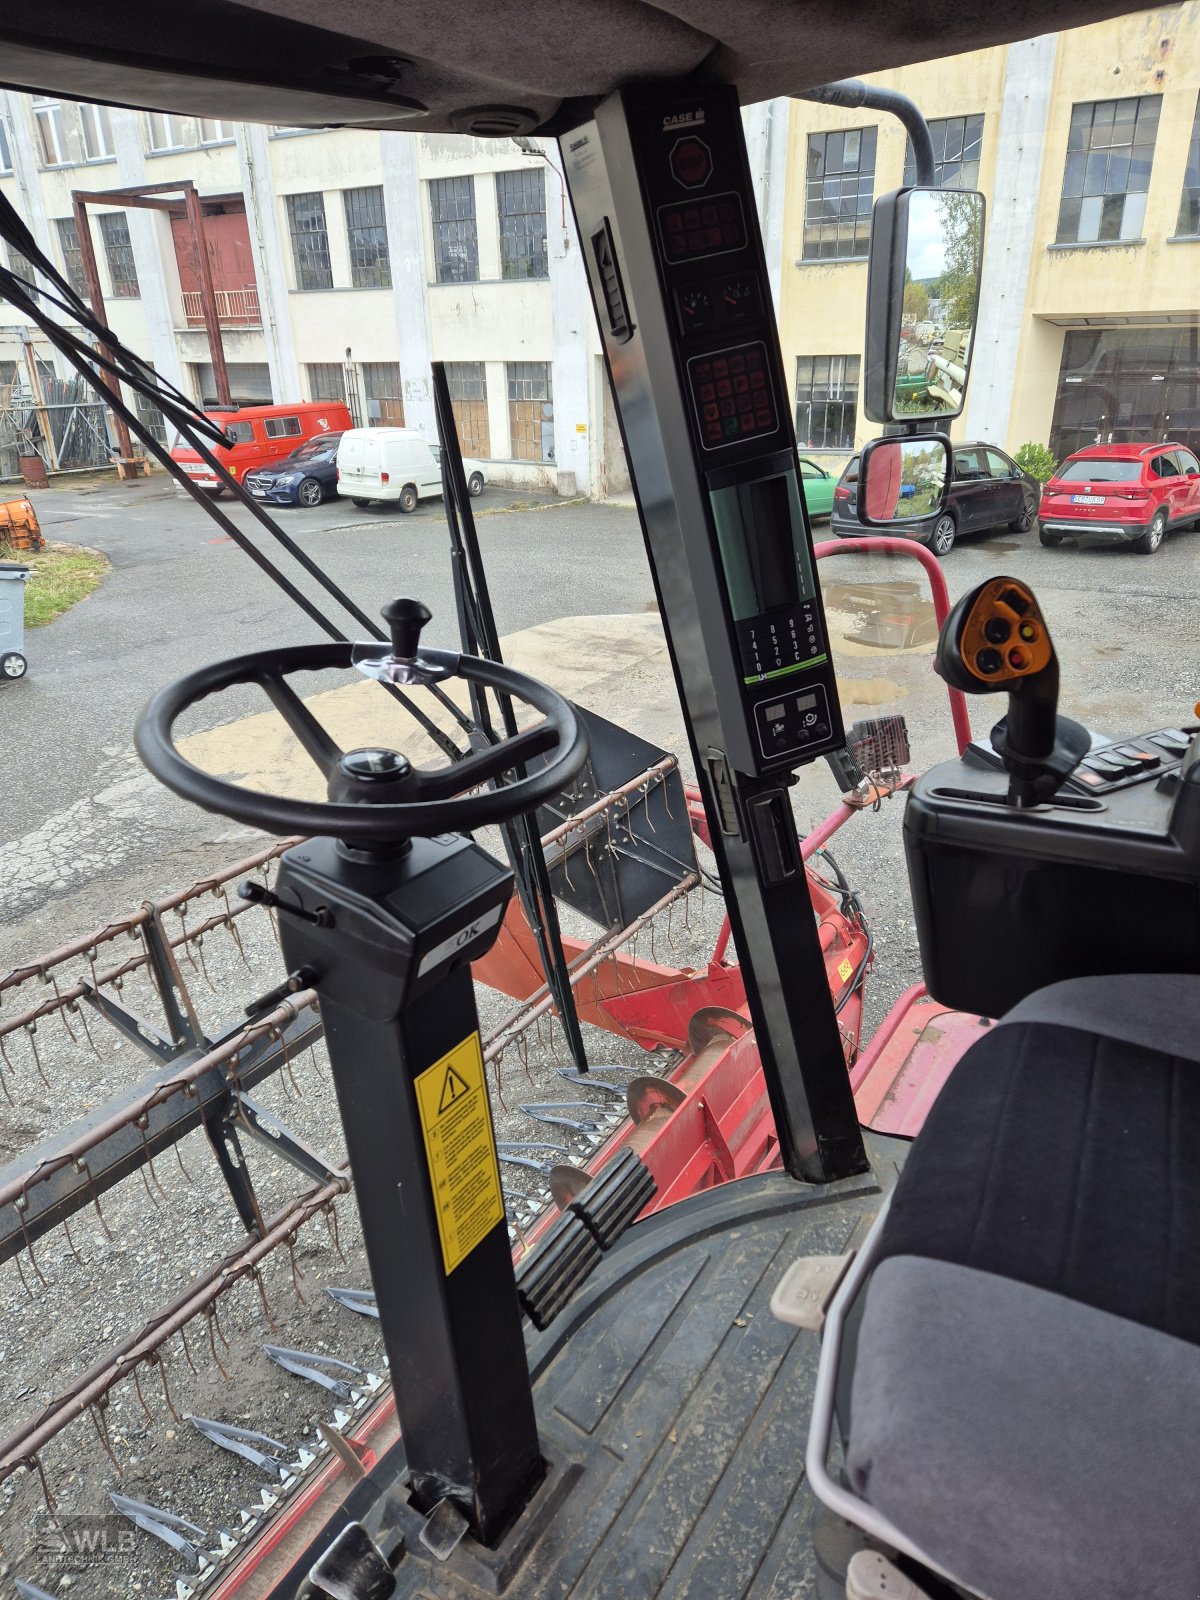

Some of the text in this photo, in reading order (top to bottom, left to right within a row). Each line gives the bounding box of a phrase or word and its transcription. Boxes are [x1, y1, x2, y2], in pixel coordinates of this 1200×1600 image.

[662, 112, 693, 125] CASE
[750, 619, 794, 639] 7 8 9
[752, 630, 796, 650] 4 5 6
[754, 641, 798, 660] 1 2 3
[756, 652, 800, 671] 0 C
